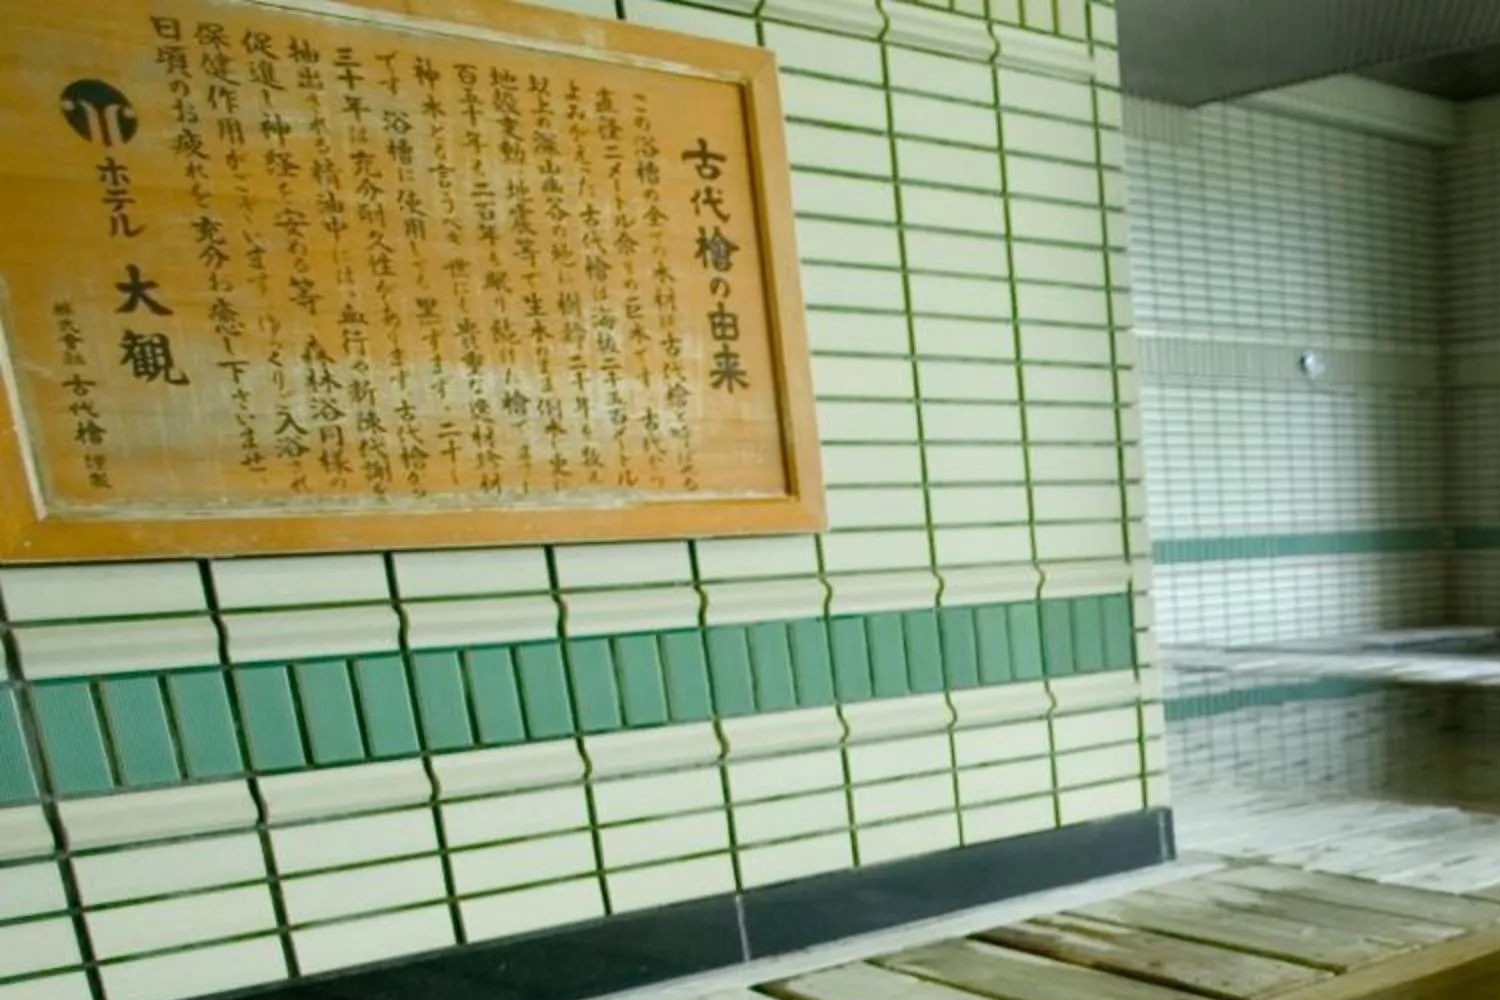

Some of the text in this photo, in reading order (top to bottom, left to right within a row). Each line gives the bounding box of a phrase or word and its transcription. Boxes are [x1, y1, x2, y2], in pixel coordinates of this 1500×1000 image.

[97, 156, 189, 385] ホテル 大観
[681, 137, 750, 393] 古代檜の由来
